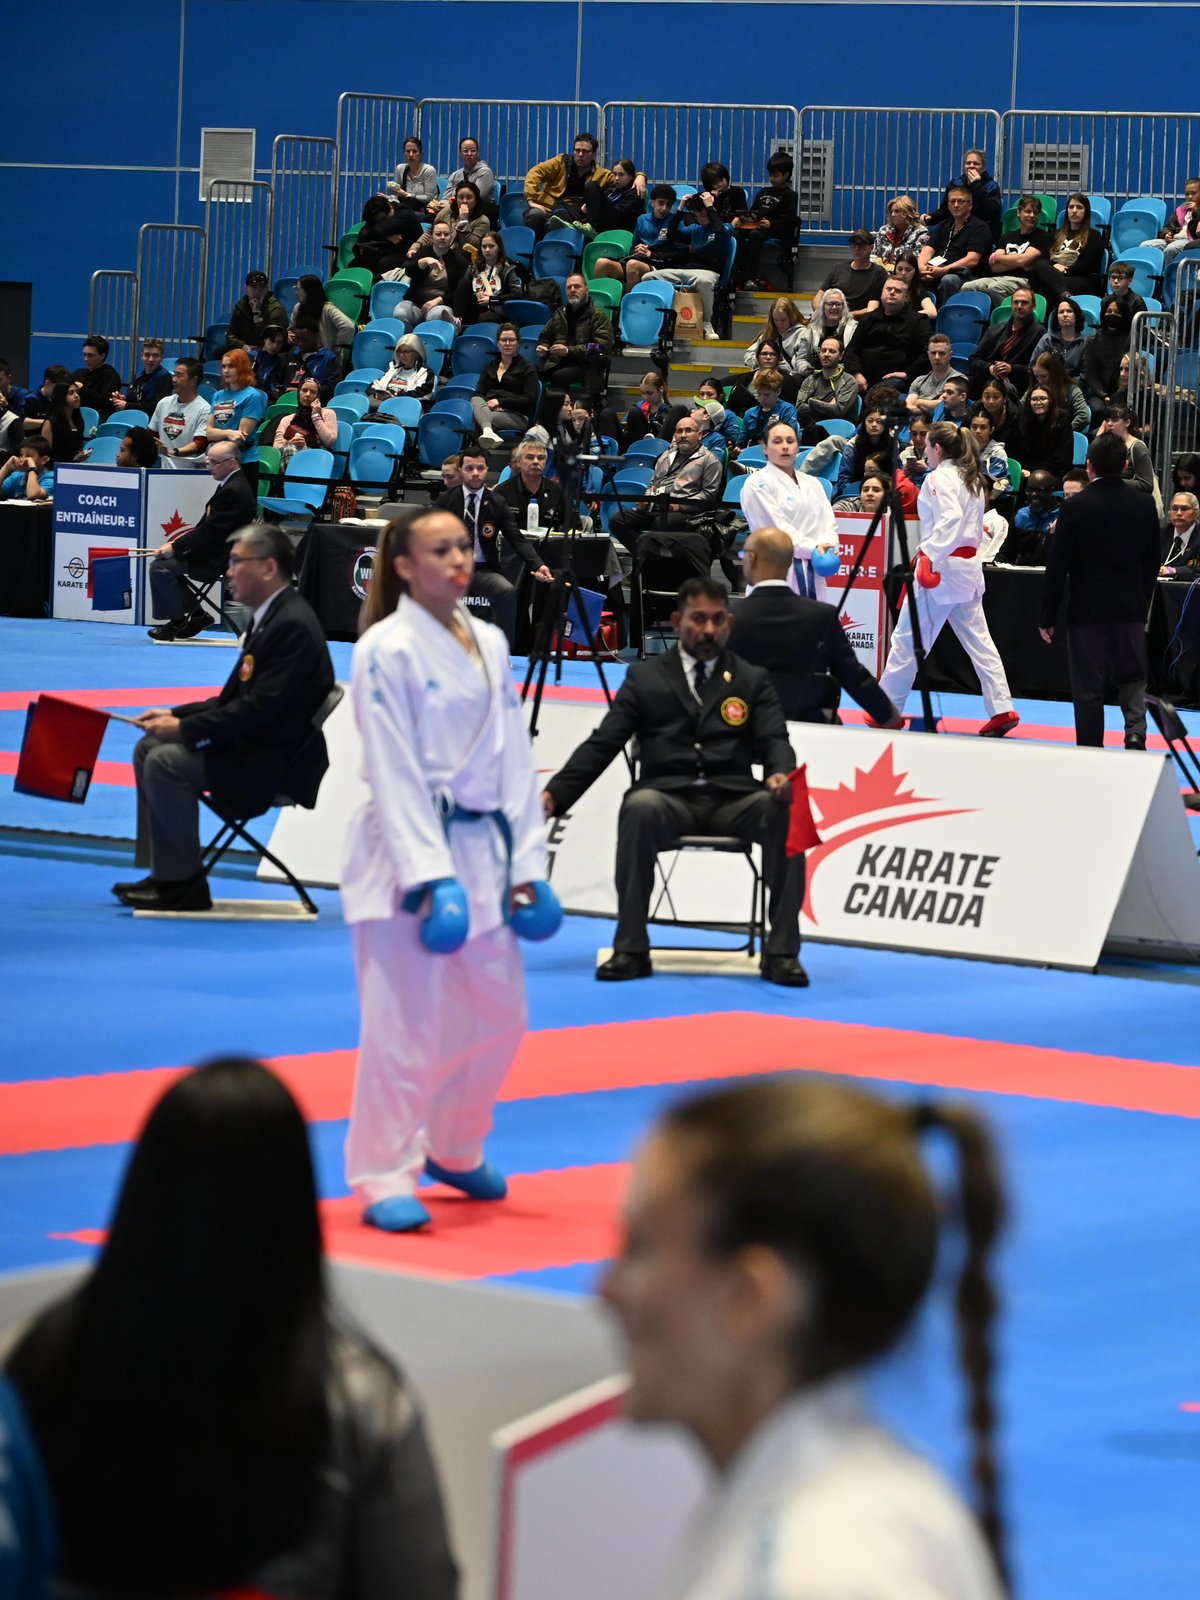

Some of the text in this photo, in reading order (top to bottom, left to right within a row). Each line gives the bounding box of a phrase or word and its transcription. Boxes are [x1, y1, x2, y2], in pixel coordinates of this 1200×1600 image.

[78, 494, 117, 507] COACH
[57, 580, 84, 589] KARATE
[847, 632, 874, 641] KARATE
[850, 641, 874, 649] ANADA
[856, 843, 1002, 889] KARATE
[843, 882, 986, 928] CANADA
